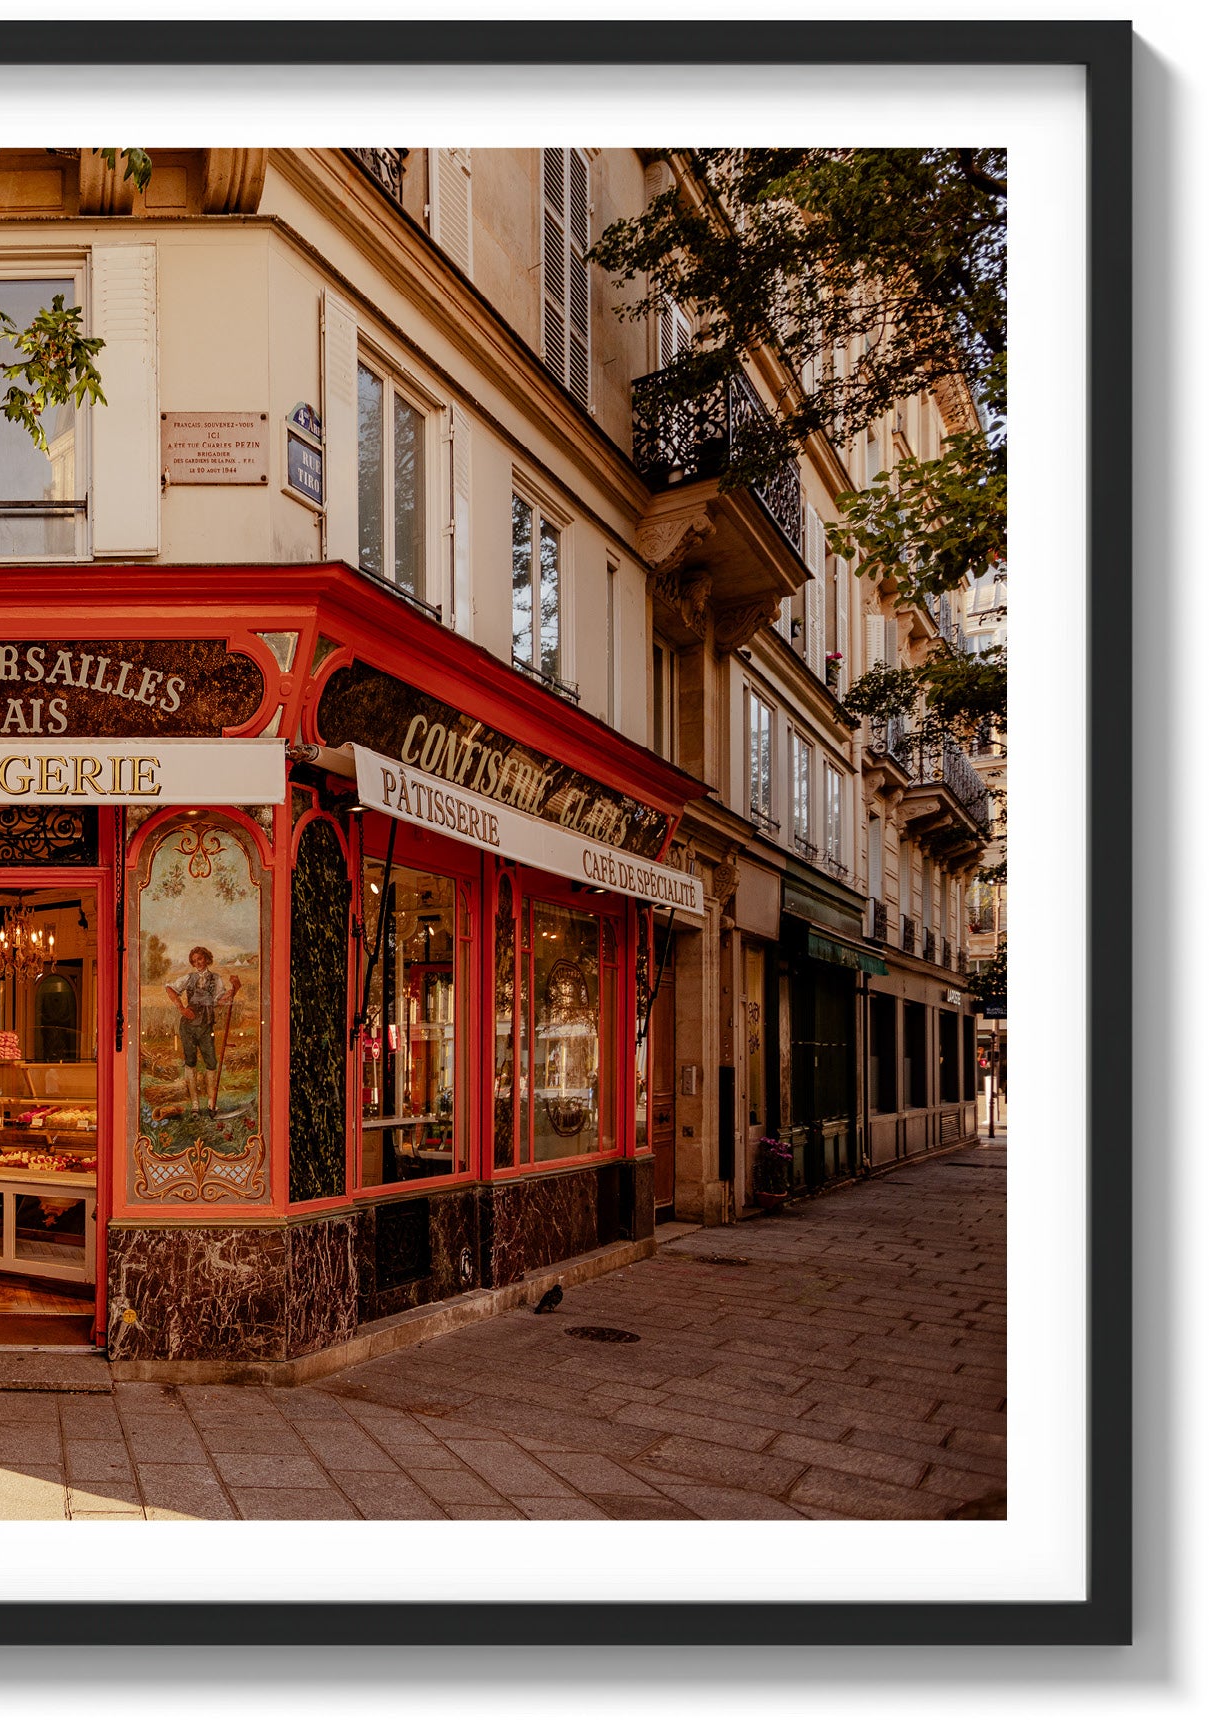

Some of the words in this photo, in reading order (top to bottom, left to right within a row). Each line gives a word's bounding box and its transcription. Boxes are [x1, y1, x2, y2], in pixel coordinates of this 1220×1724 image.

[297, 467, 321, 493] TIRO
[302, 450, 321, 475] RUE
[380, 767, 500, 848] PÂTISSERIE
[401, 714, 554, 817] CONFISERIE
[559, 787, 632, 847] GLACES
[582, 848, 617, 886] CAFÉ
[618, 862, 636, 892] DE
[636, 863, 696, 908] SPÉCIALITÉ
